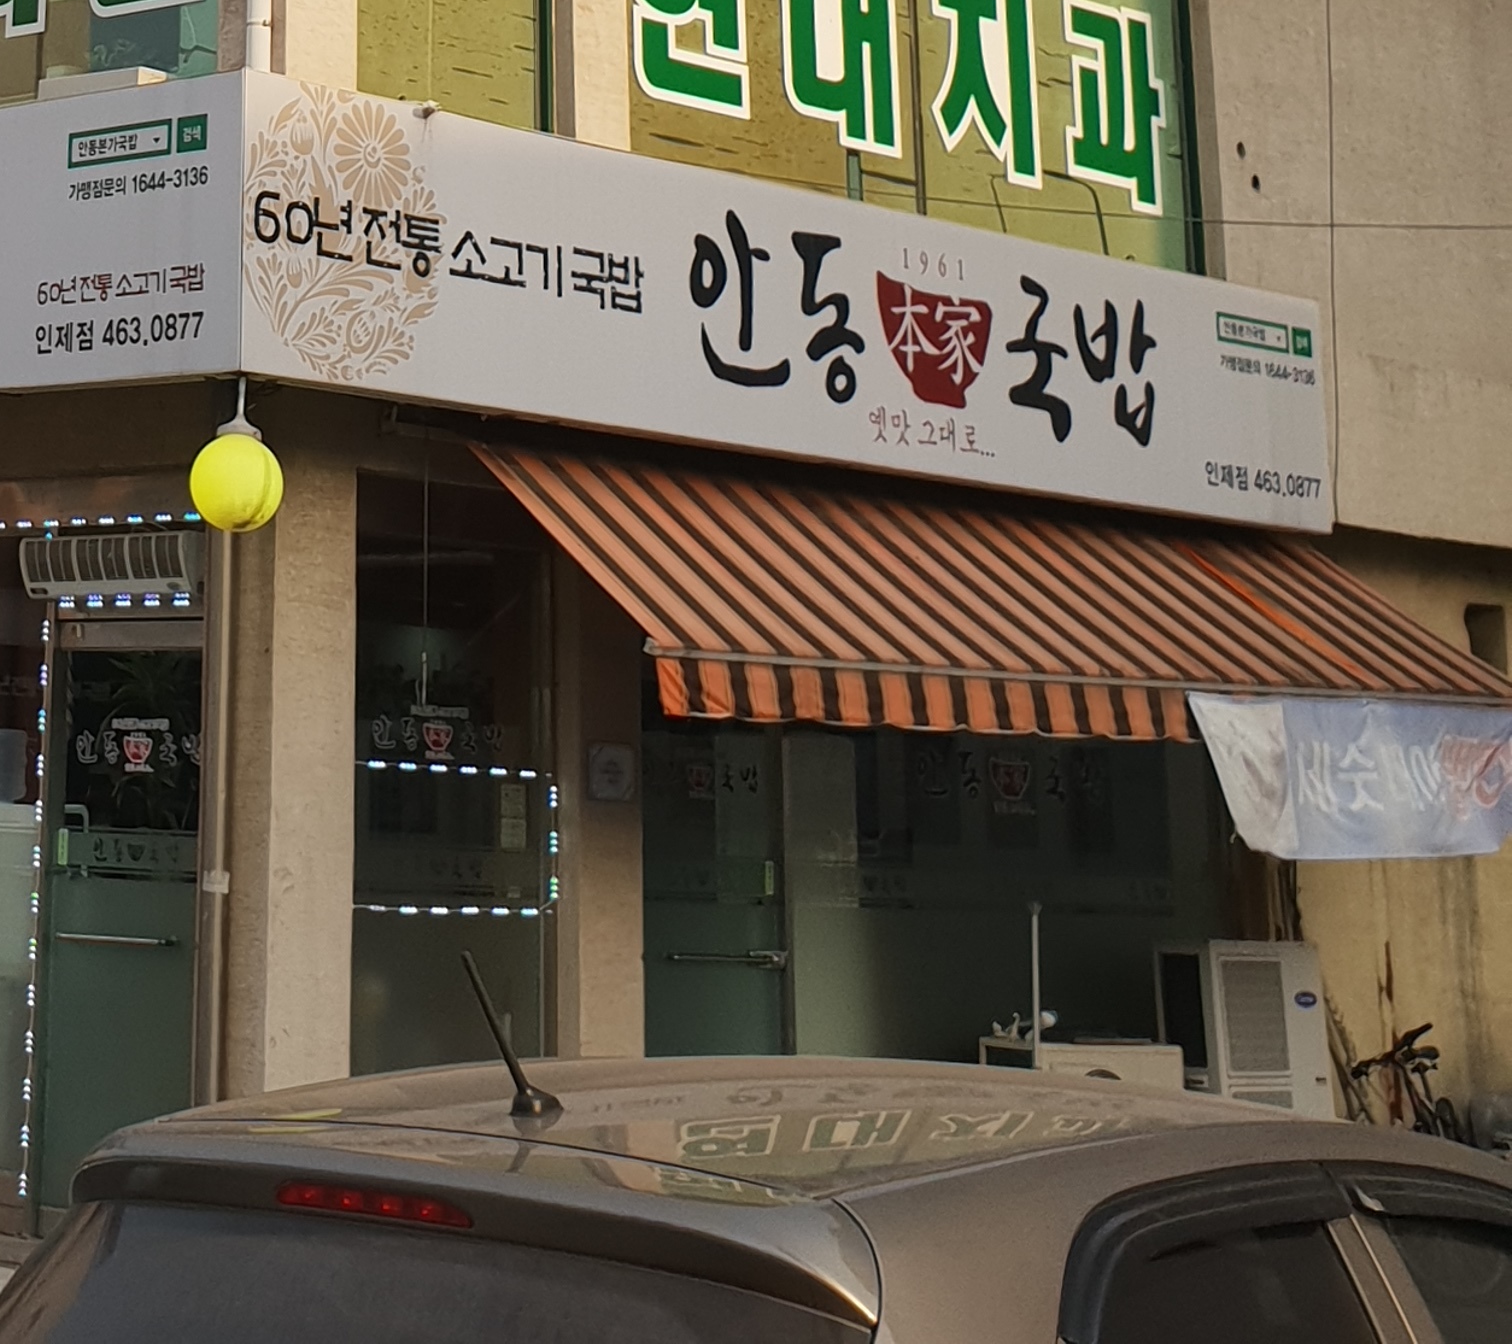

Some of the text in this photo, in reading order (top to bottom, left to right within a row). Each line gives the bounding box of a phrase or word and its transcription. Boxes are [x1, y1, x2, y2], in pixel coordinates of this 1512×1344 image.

[77, 133, 139, 158] 안동본가국밥
[68, 165, 210, 202] 가맹점문의 1644-3136
[902, 247, 966, 282] 1961
[35, 310, 204, 355] 인제점 463.0877
[1204, 460, 1250, 492] 인제점
